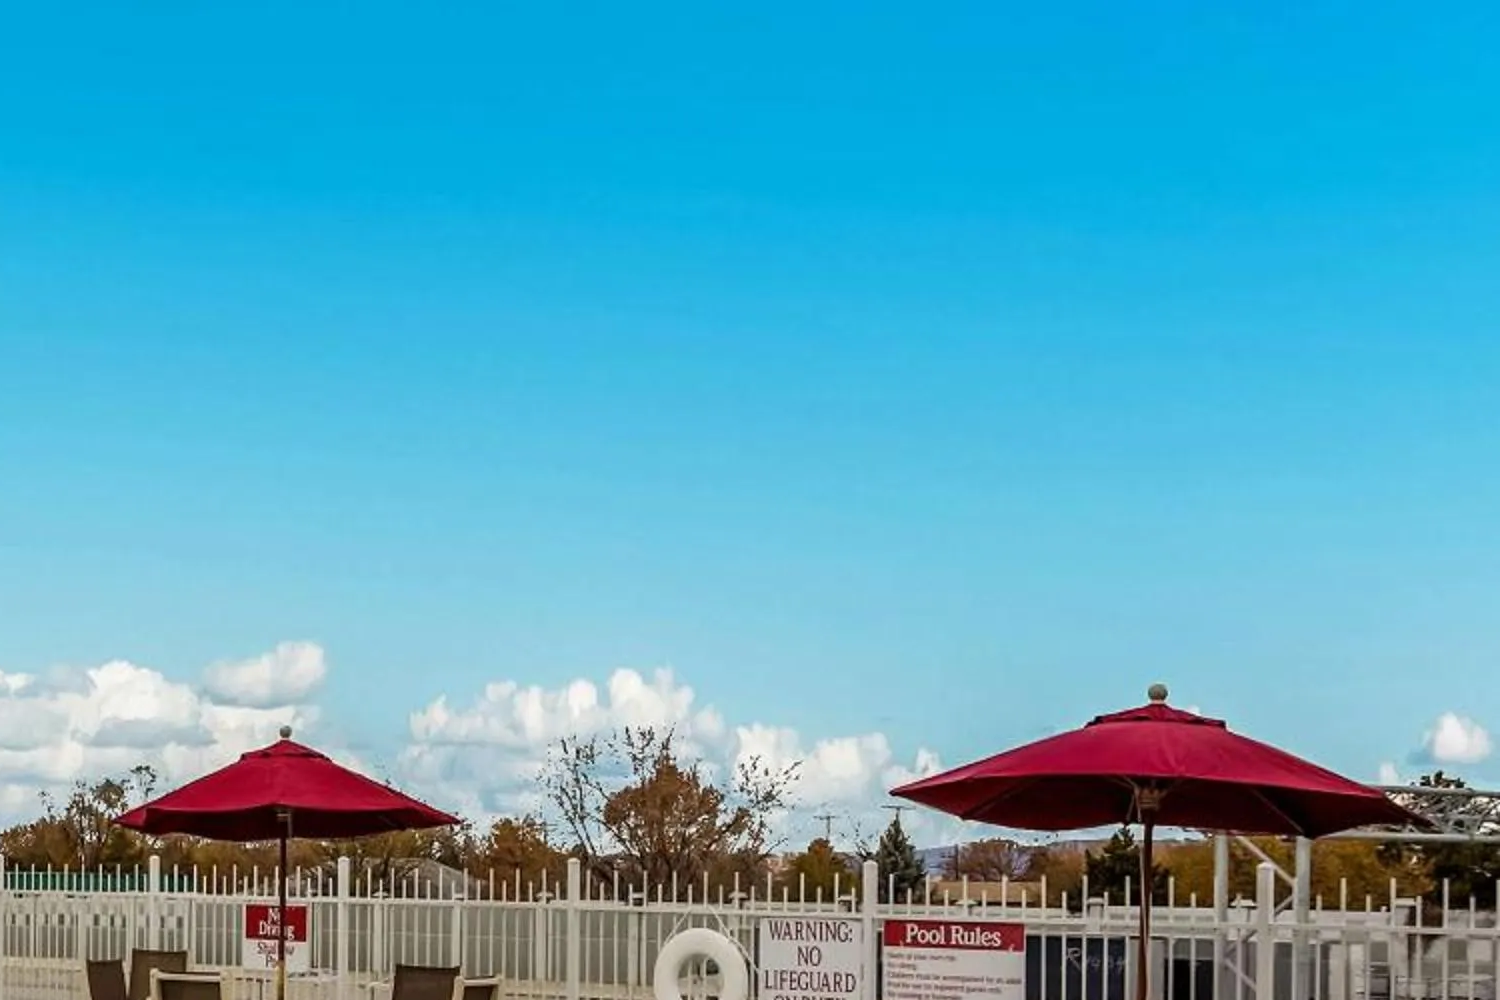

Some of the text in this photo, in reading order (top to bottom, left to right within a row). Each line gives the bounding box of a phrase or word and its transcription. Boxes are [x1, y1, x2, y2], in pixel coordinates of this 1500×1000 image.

[768, 919, 853, 943] WARNING:
[905, 923, 1002, 947] Pool Rules
[797, 946, 822, 967] NO
[764, 969, 857, 993] LIFEGUARD
